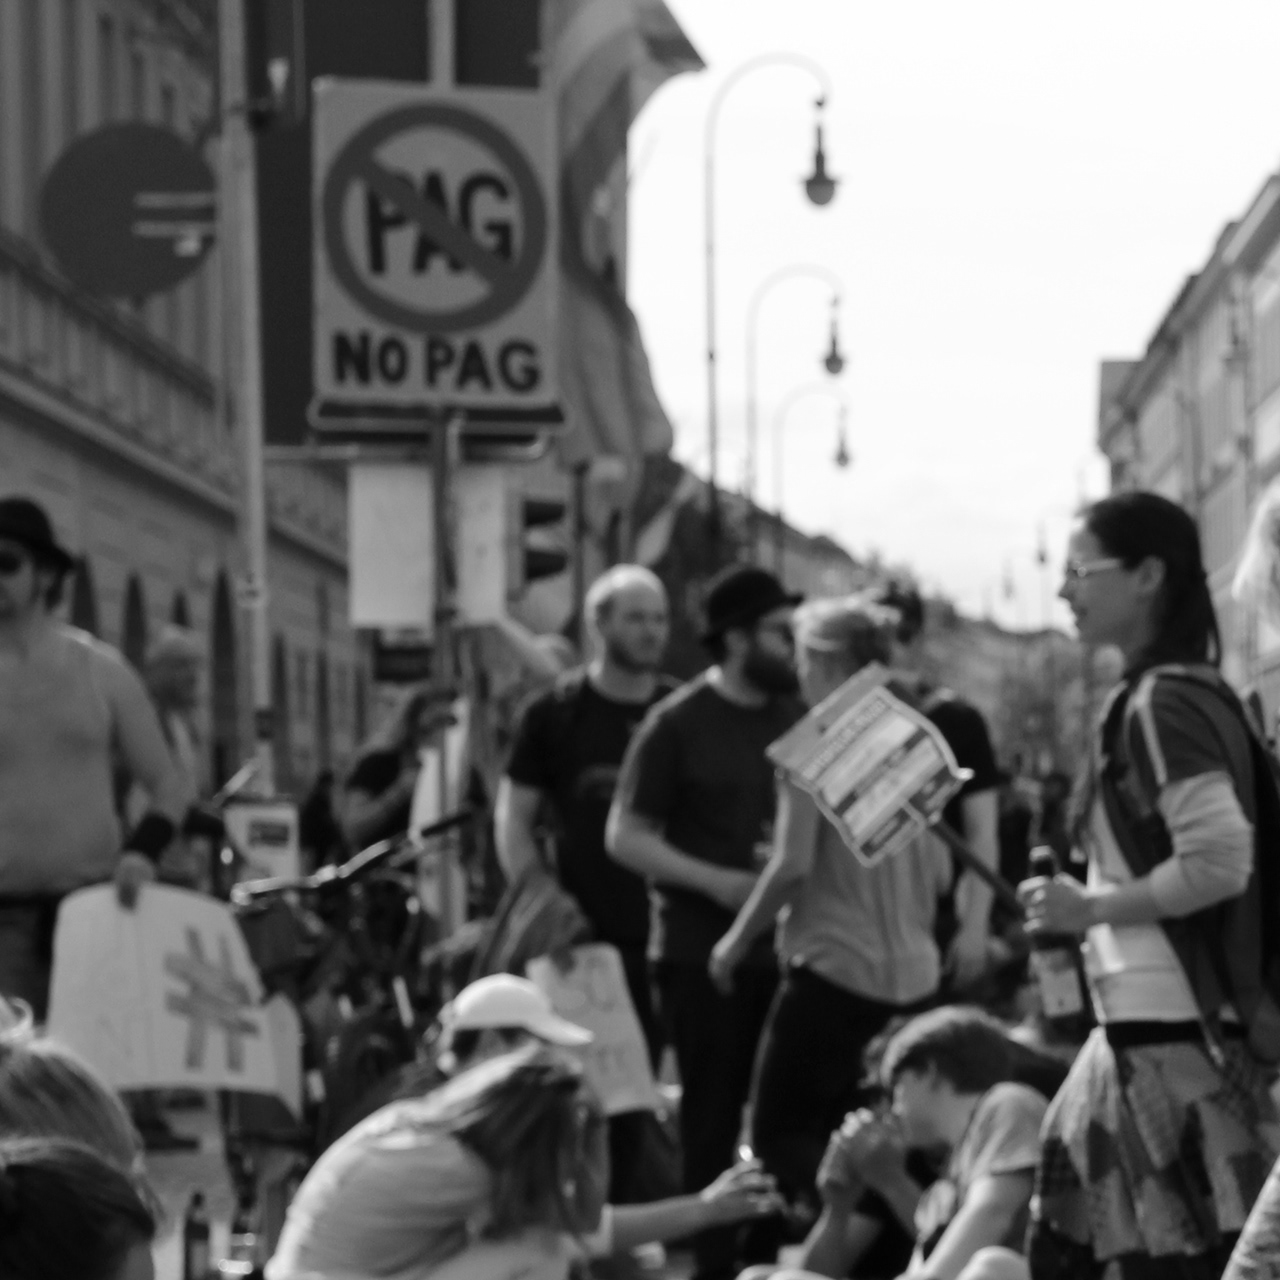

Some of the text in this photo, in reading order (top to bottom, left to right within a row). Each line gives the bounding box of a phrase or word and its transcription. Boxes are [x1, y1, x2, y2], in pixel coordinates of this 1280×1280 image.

[364, 168, 514, 276] PAG
[332, 331, 542, 394] NO PAG
